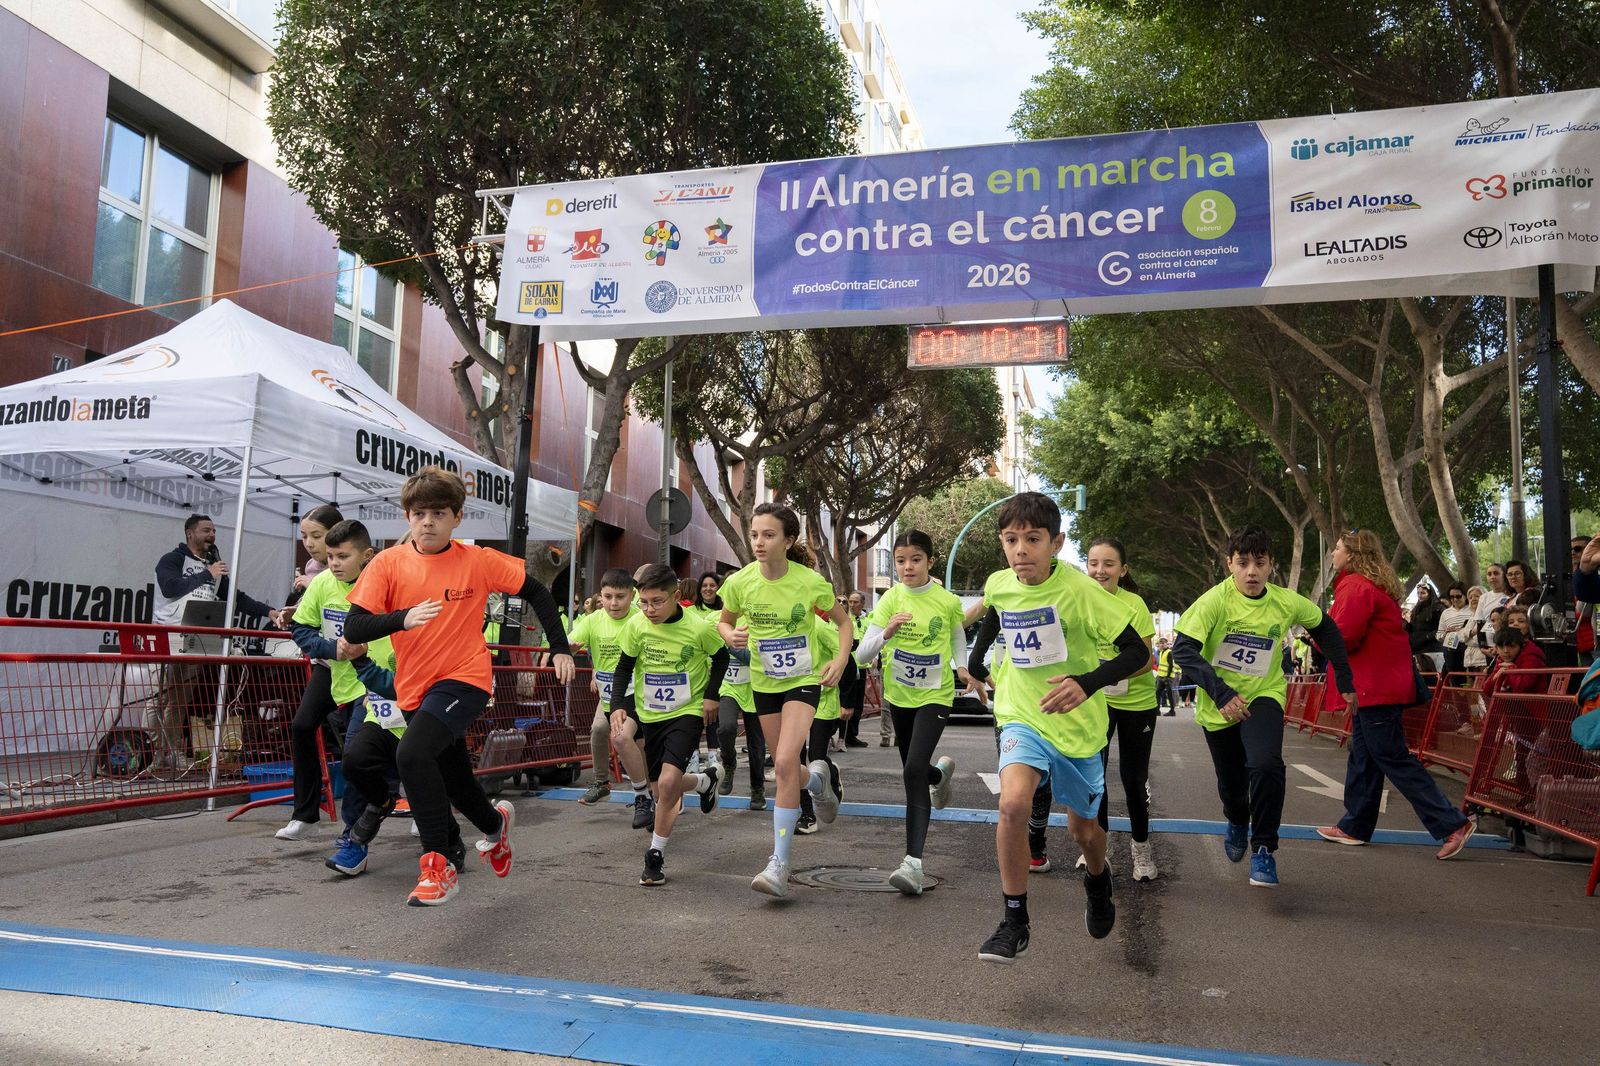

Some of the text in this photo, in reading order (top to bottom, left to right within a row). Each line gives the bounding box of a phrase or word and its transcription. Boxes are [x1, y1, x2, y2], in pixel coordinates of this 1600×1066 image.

[1324, 135, 1414, 157] cajamar
[1455, 132, 1526, 146] MICHELIN
[1368, 149, 1388, 157] CAJA
[780, 145, 1236, 211] II Almería en marcha
[1512, 166, 1590, 179] FUNDACIÓN
[1512, 174, 1594, 197] primaflor
[1290, 193, 1413, 213] Isabel Alonso
[1200, 198, 1218, 224] 8
[794, 205, 1164, 257] contra el cáncer
[1196, 225, 1222, 233] Febrero
[1508, 219, 1558, 232] Toyota
[1304, 234, 1408, 257] LEALTADIS
[1510, 231, 1564, 246] Alborán
[516, 255, 551, 264] ALMERÍA
[697, 248, 738, 257] Almería 2005
[1137, 245, 1239, 260] asociación española
[1326, 254, 1385, 264] ABOGADOS
[1139, 258, 1218, 270] contra el cáncer
[966, 263, 1031, 288] 2026
[1139, 270, 1196, 281] en Almería
[678, 284, 743, 295] UNIVERSIDAD
[792, 278, 920, 295] #TodosContraElCáncer
[534, 298, 559, 306] CABRAS
[678, 294, 742, 305] DE ALMERÍA
[0, 395, 151, 426] zandolameta
[1013, 631, 1042, 652] 44
[772, 652, 797, 668] 35
[1231, 648, 1257, 664] 45
[726, 667, 740, 678] 37
[904, 665, 927, 680] 34
[654, 687, 676, 702] 42
[371, 702, 392, 718] 38
